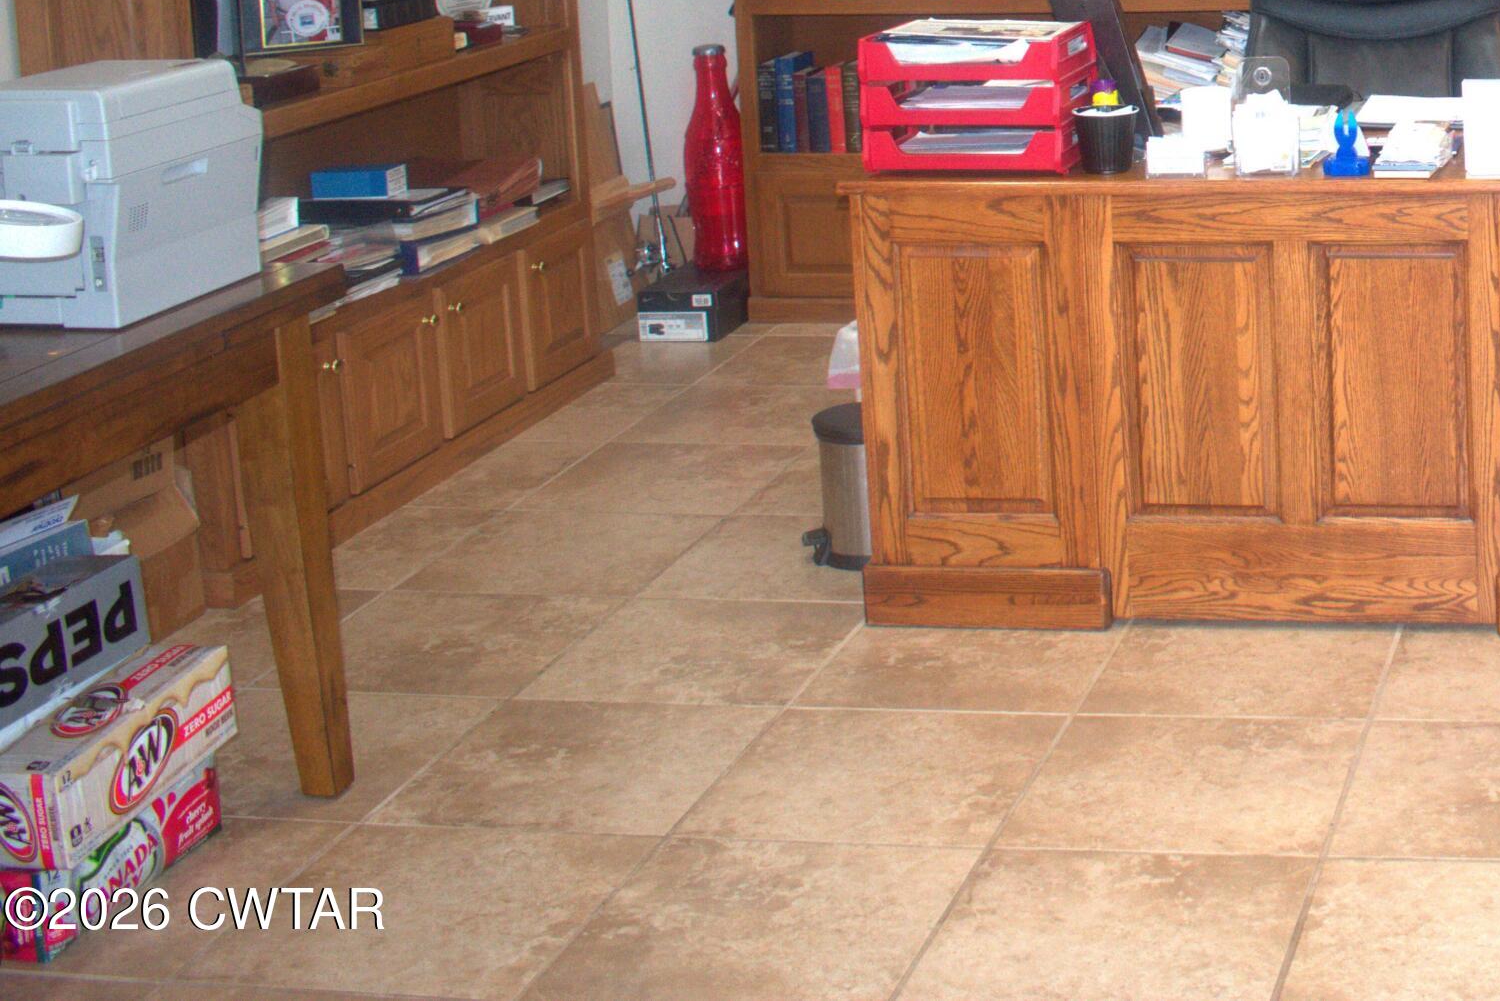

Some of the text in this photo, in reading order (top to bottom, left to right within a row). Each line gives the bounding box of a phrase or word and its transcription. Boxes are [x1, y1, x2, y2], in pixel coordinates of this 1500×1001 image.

[0, 579, 138, 709] PEPS
[183, 690, 233, 738] ZERO SUGAR
[125, 716, 163, 802] A&W
